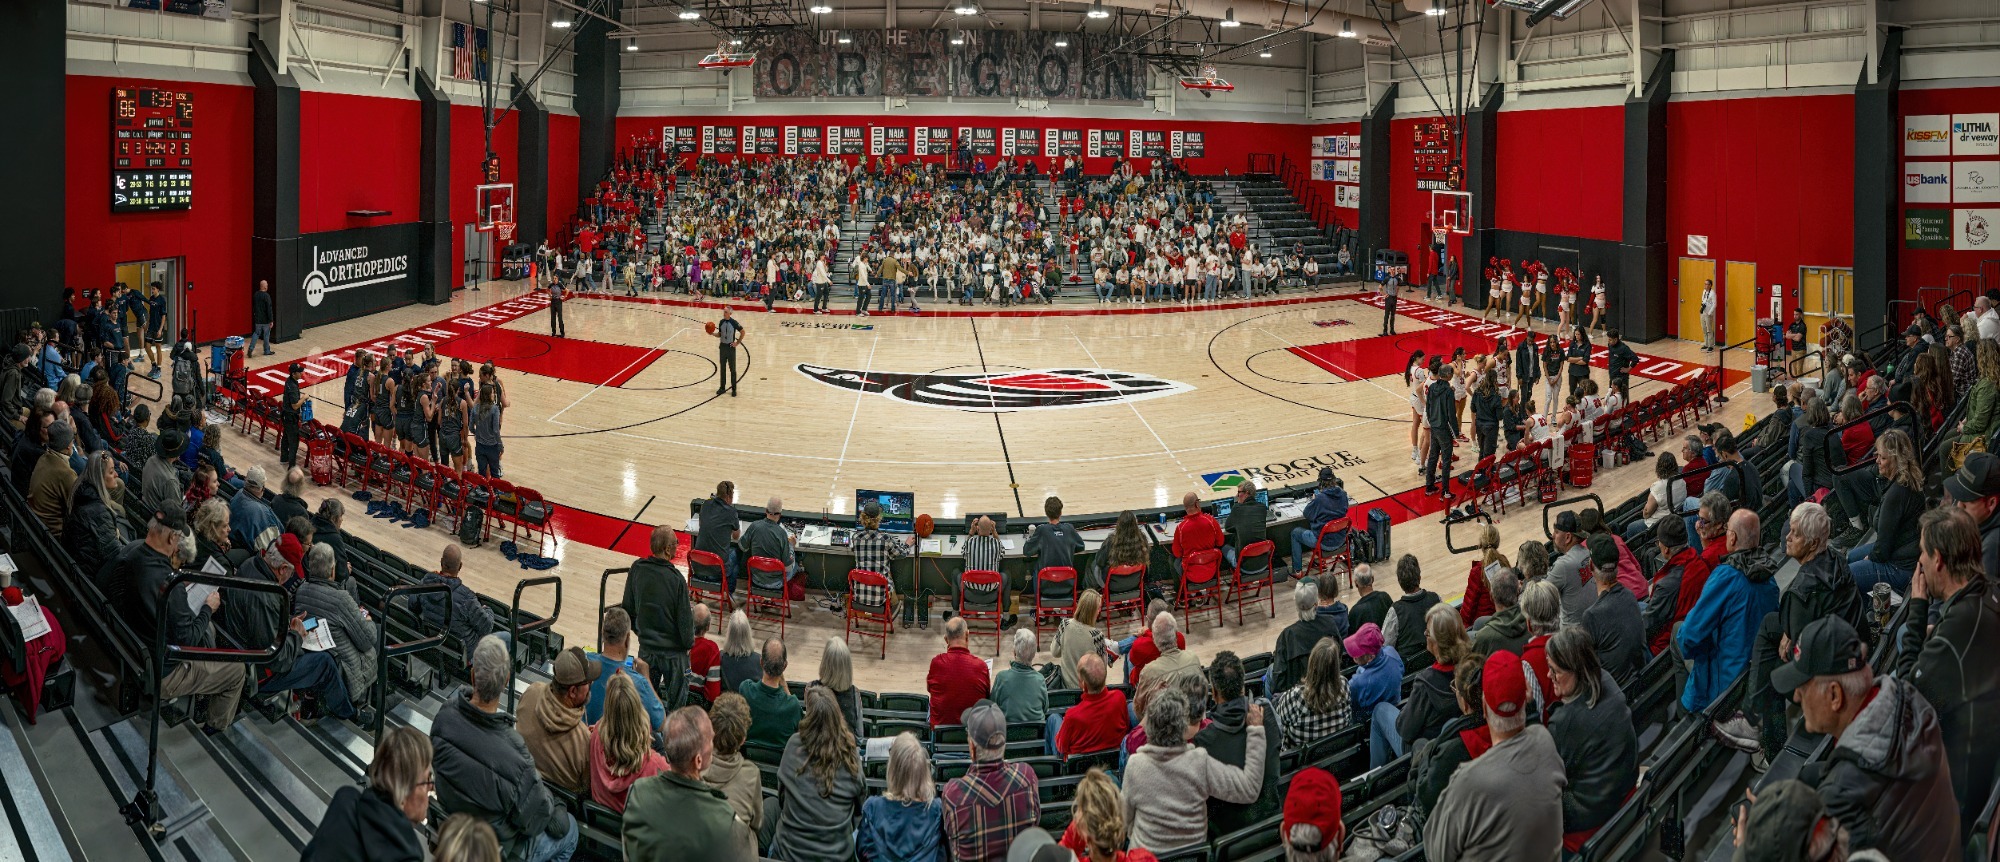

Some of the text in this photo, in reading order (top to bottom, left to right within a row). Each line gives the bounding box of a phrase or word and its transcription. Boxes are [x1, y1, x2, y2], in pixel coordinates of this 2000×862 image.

[152, 91, 172, 107] 1:39
[120, 100, 135, 117] 86
[179, 102, 192, 118] 72
[1962, 122, 1991, 132] LITHIA
[678, 128, 693, 137] NAIA
[719, 128, 733, 137] NAIA
[760, 128, 775, 137] NAIA
[802, 128, 817, 138] NAIA
[845, 128, 860, 137] NAIA
[888, 128, 904, 138] NAIA
[932, 128, 948, 138] NAIA
[977, 129, 992, 138] NAIA
[1020, 129, 1035, 139] NAIA
[1063, 131, 1078, 140] NAIA
[1105, 132, 1120, 141] NAIA
[1146, 132, 1161, 142] NAIA
[1187, 133, 1201, 142] NAIA
[1907, 130, 1948, 140] KISSFM
[745, 128, 754, 152] 1994
[787, 128, 796, 152] 2001
[830, 128, 838, 152] 2010
[874, 129, 882, 153] 2010
[917, 128, 926, 153] 2014
[1005, 130, 1014, 154] 2018
[1090, 131, 1098, 155] 2021
[123, 142, 128, 153] 4
[136, 143, 141, 153] 3
[170, 143, 175, 154] 2
[185, 143, 190, 154] 3
[320, 246, 368, 264] ADVANCED
[329, 255, 407, 282] ORTHOPEDICS
[890, 500, 900, 514] LC
